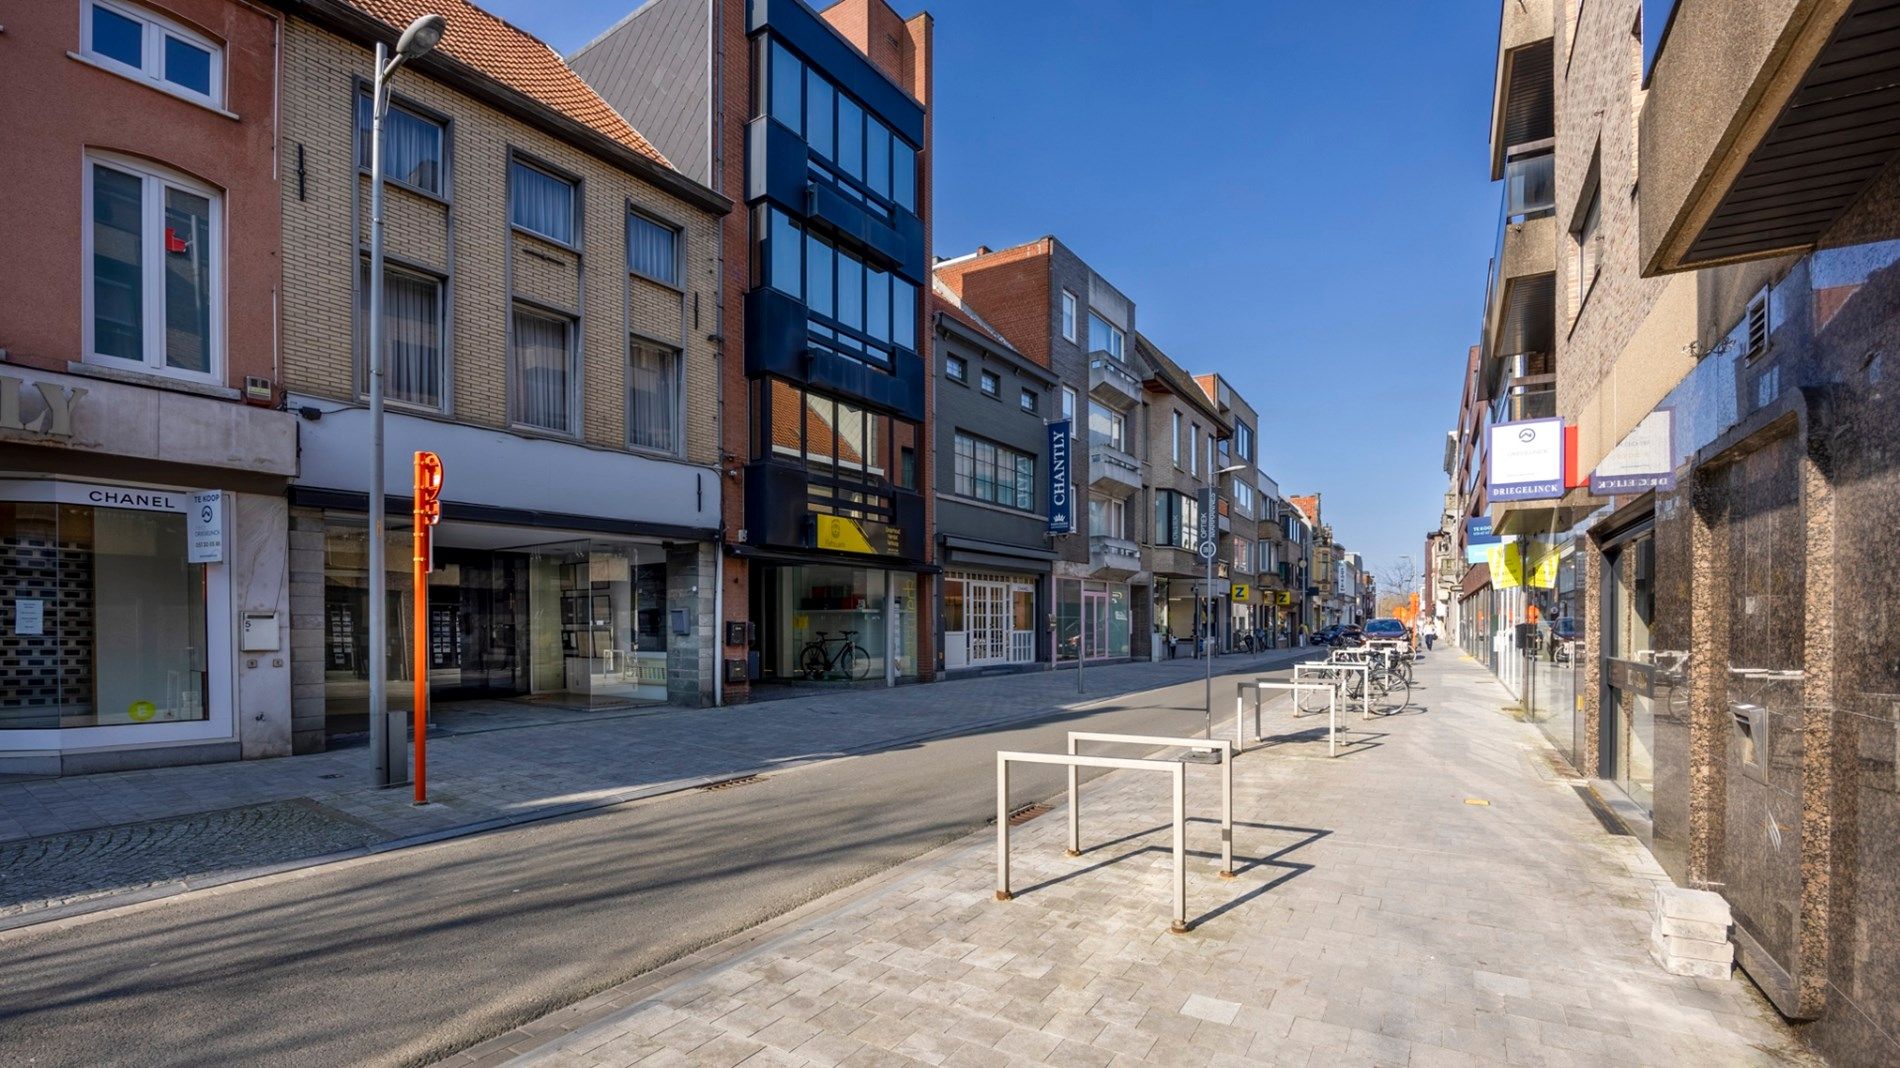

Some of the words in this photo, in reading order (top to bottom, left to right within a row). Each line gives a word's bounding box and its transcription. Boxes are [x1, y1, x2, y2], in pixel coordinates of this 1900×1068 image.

[1053, 431, 1065, 506] CHANTLY
[1493, 484, 1558, 496] DRIEGELINCK
[89, 491, 175, 508] CHANEL
[203, 494, 220, 502] KOOP
[1200, 512, 1208, 539] OPTIEK
[1235, 587, 1244, 598] Z
[1279, 594, 1286, 603] Z
